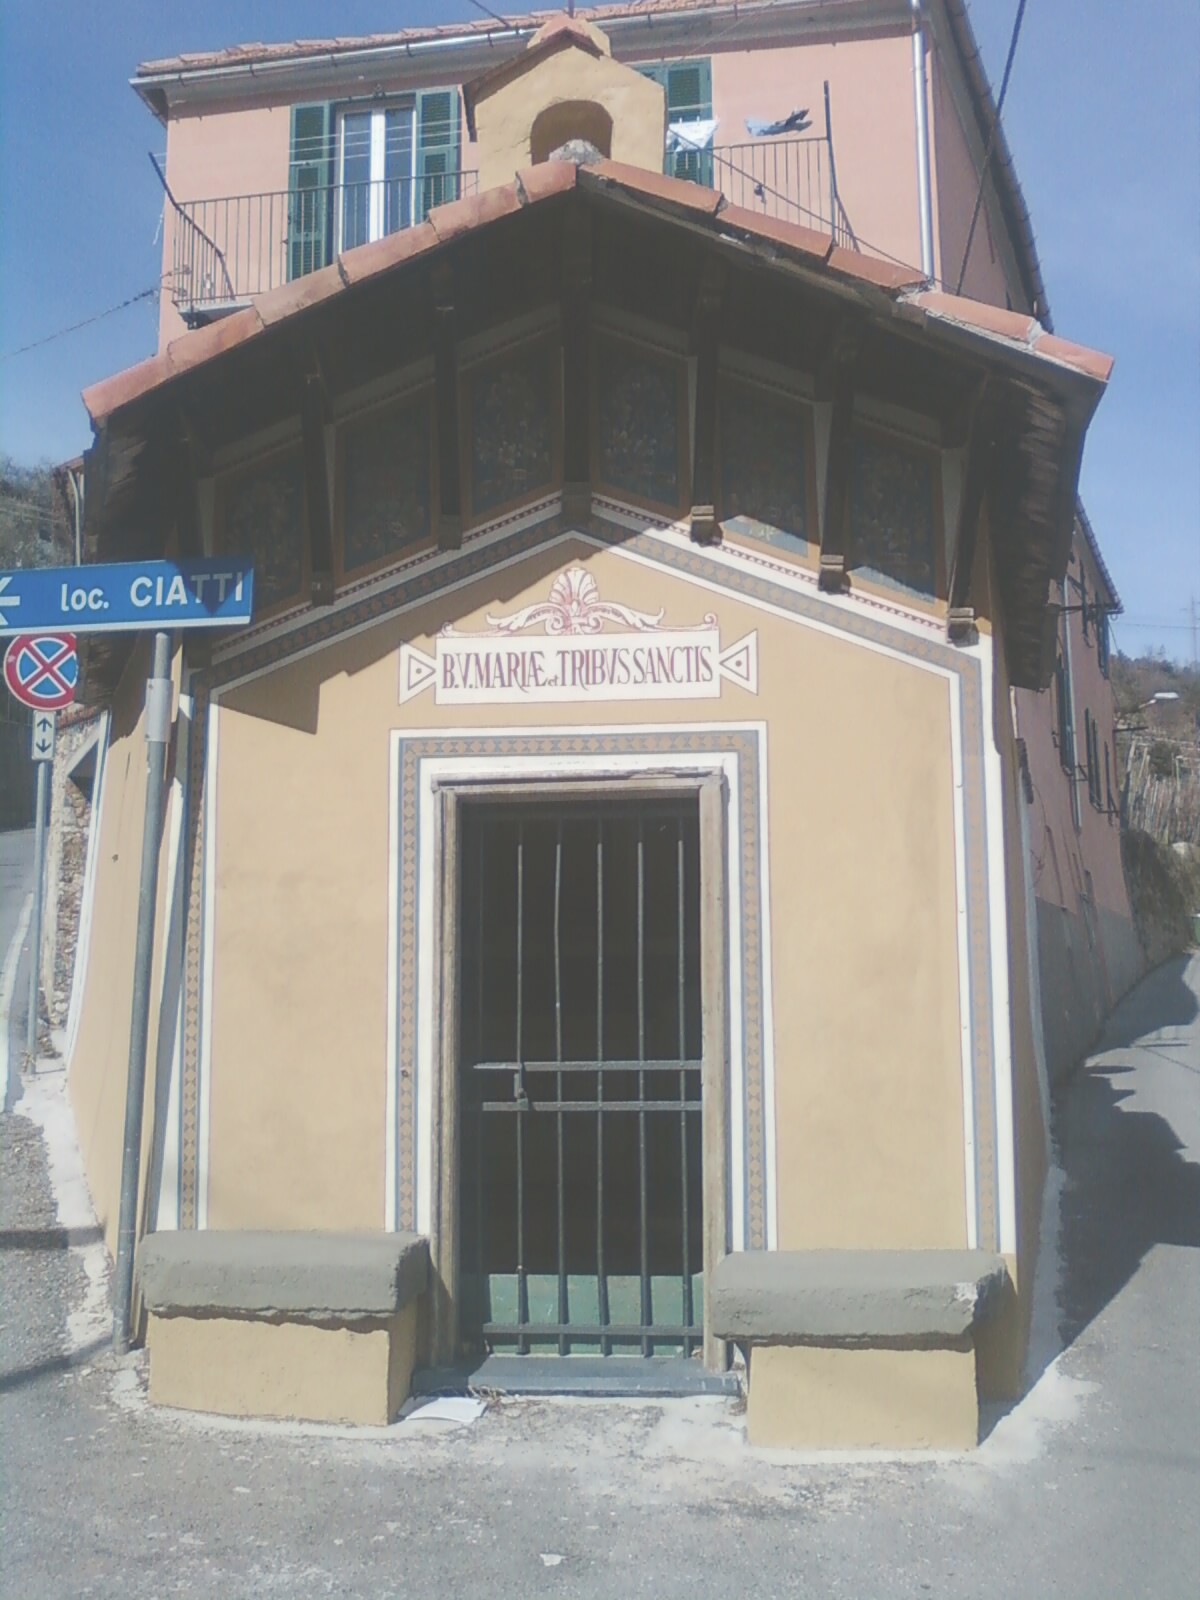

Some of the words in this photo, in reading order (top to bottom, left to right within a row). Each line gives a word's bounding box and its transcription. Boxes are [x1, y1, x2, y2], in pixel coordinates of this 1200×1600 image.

[61, 584, 109, 611] loc.
[130, 572, 243, 607] CIATTI
[556, 648, 630, 691] TRIBVS
[633, 645, 713, 684] SANCTIS
